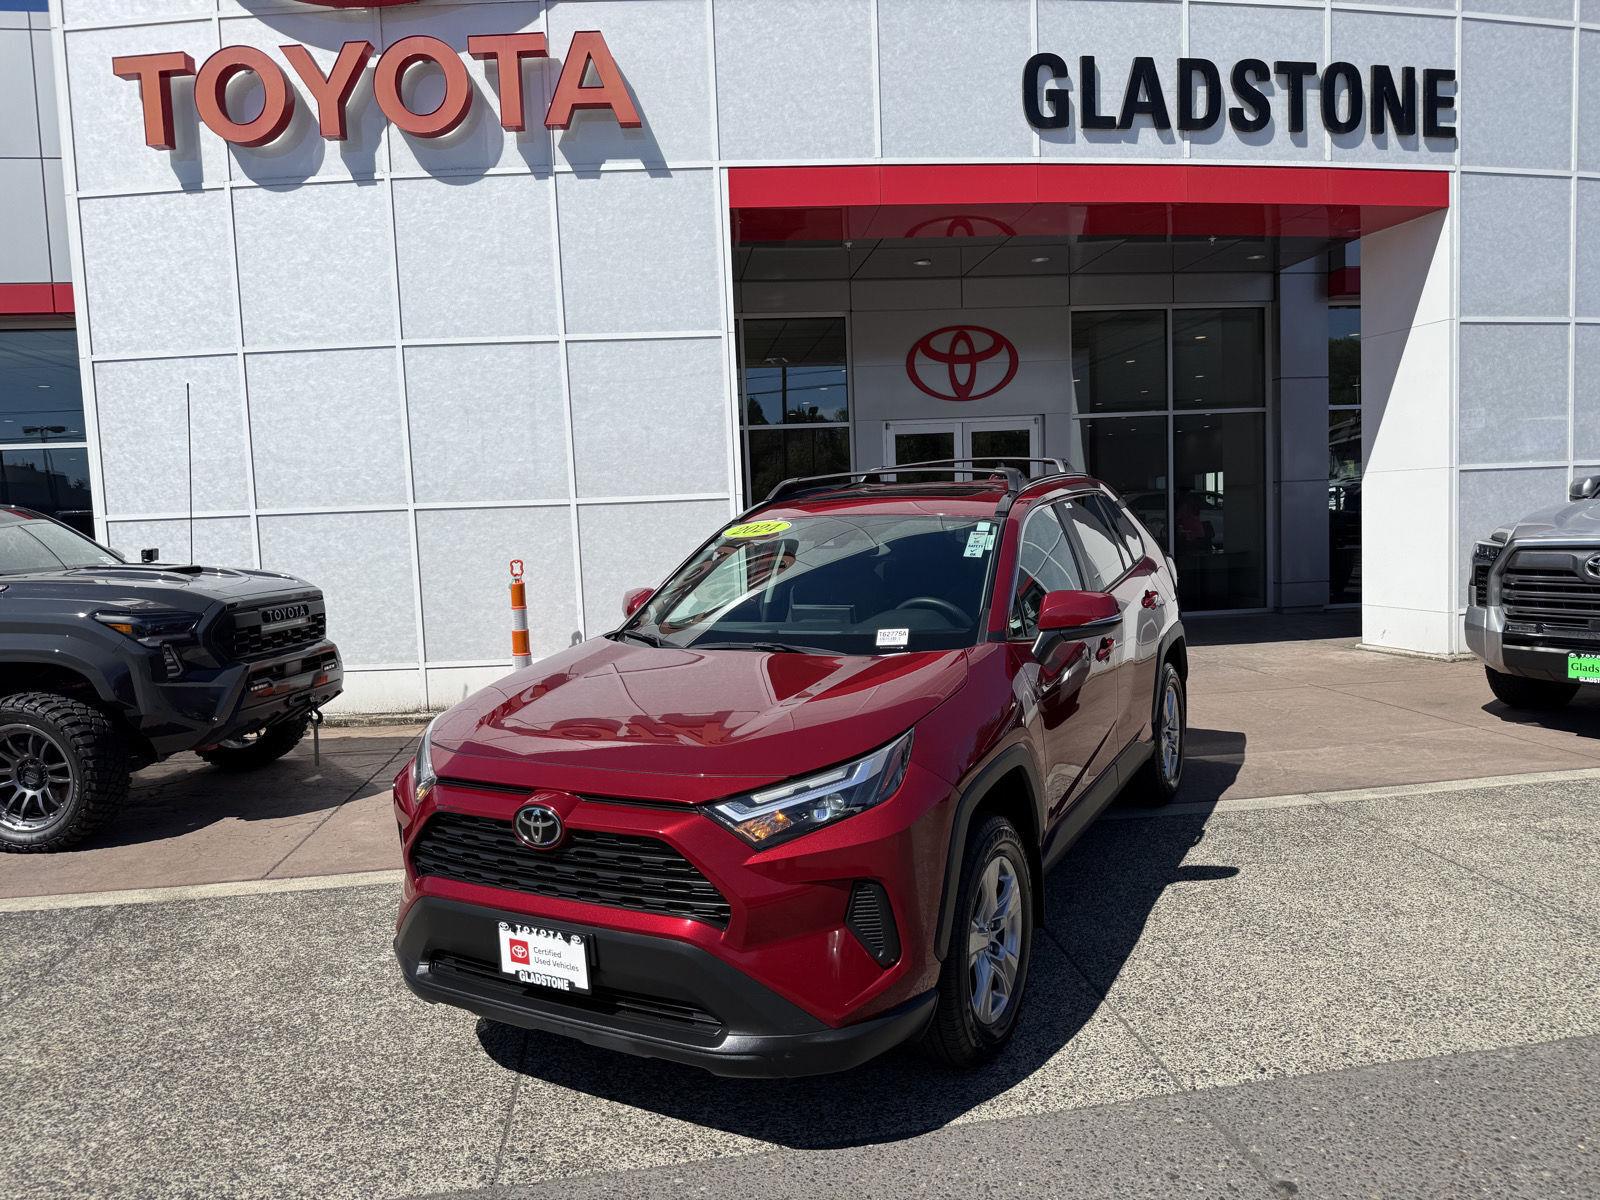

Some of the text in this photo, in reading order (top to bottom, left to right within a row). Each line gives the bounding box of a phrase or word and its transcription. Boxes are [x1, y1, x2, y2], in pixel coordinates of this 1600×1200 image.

[113, 30, 643, 151] TOYOTA
[1022, 52, 1457, 139] GLADSTONE
[729, 523, 782, 536] 2024
[267, 606, 306, 621] TOYOTA
[515, 924, 564, 940] TOYOTA
[533, 946, 562, 958] Certified
[534, 957, 579, 972] Used Vehicles
[519, 970, 570, 991] GLADSTONE
